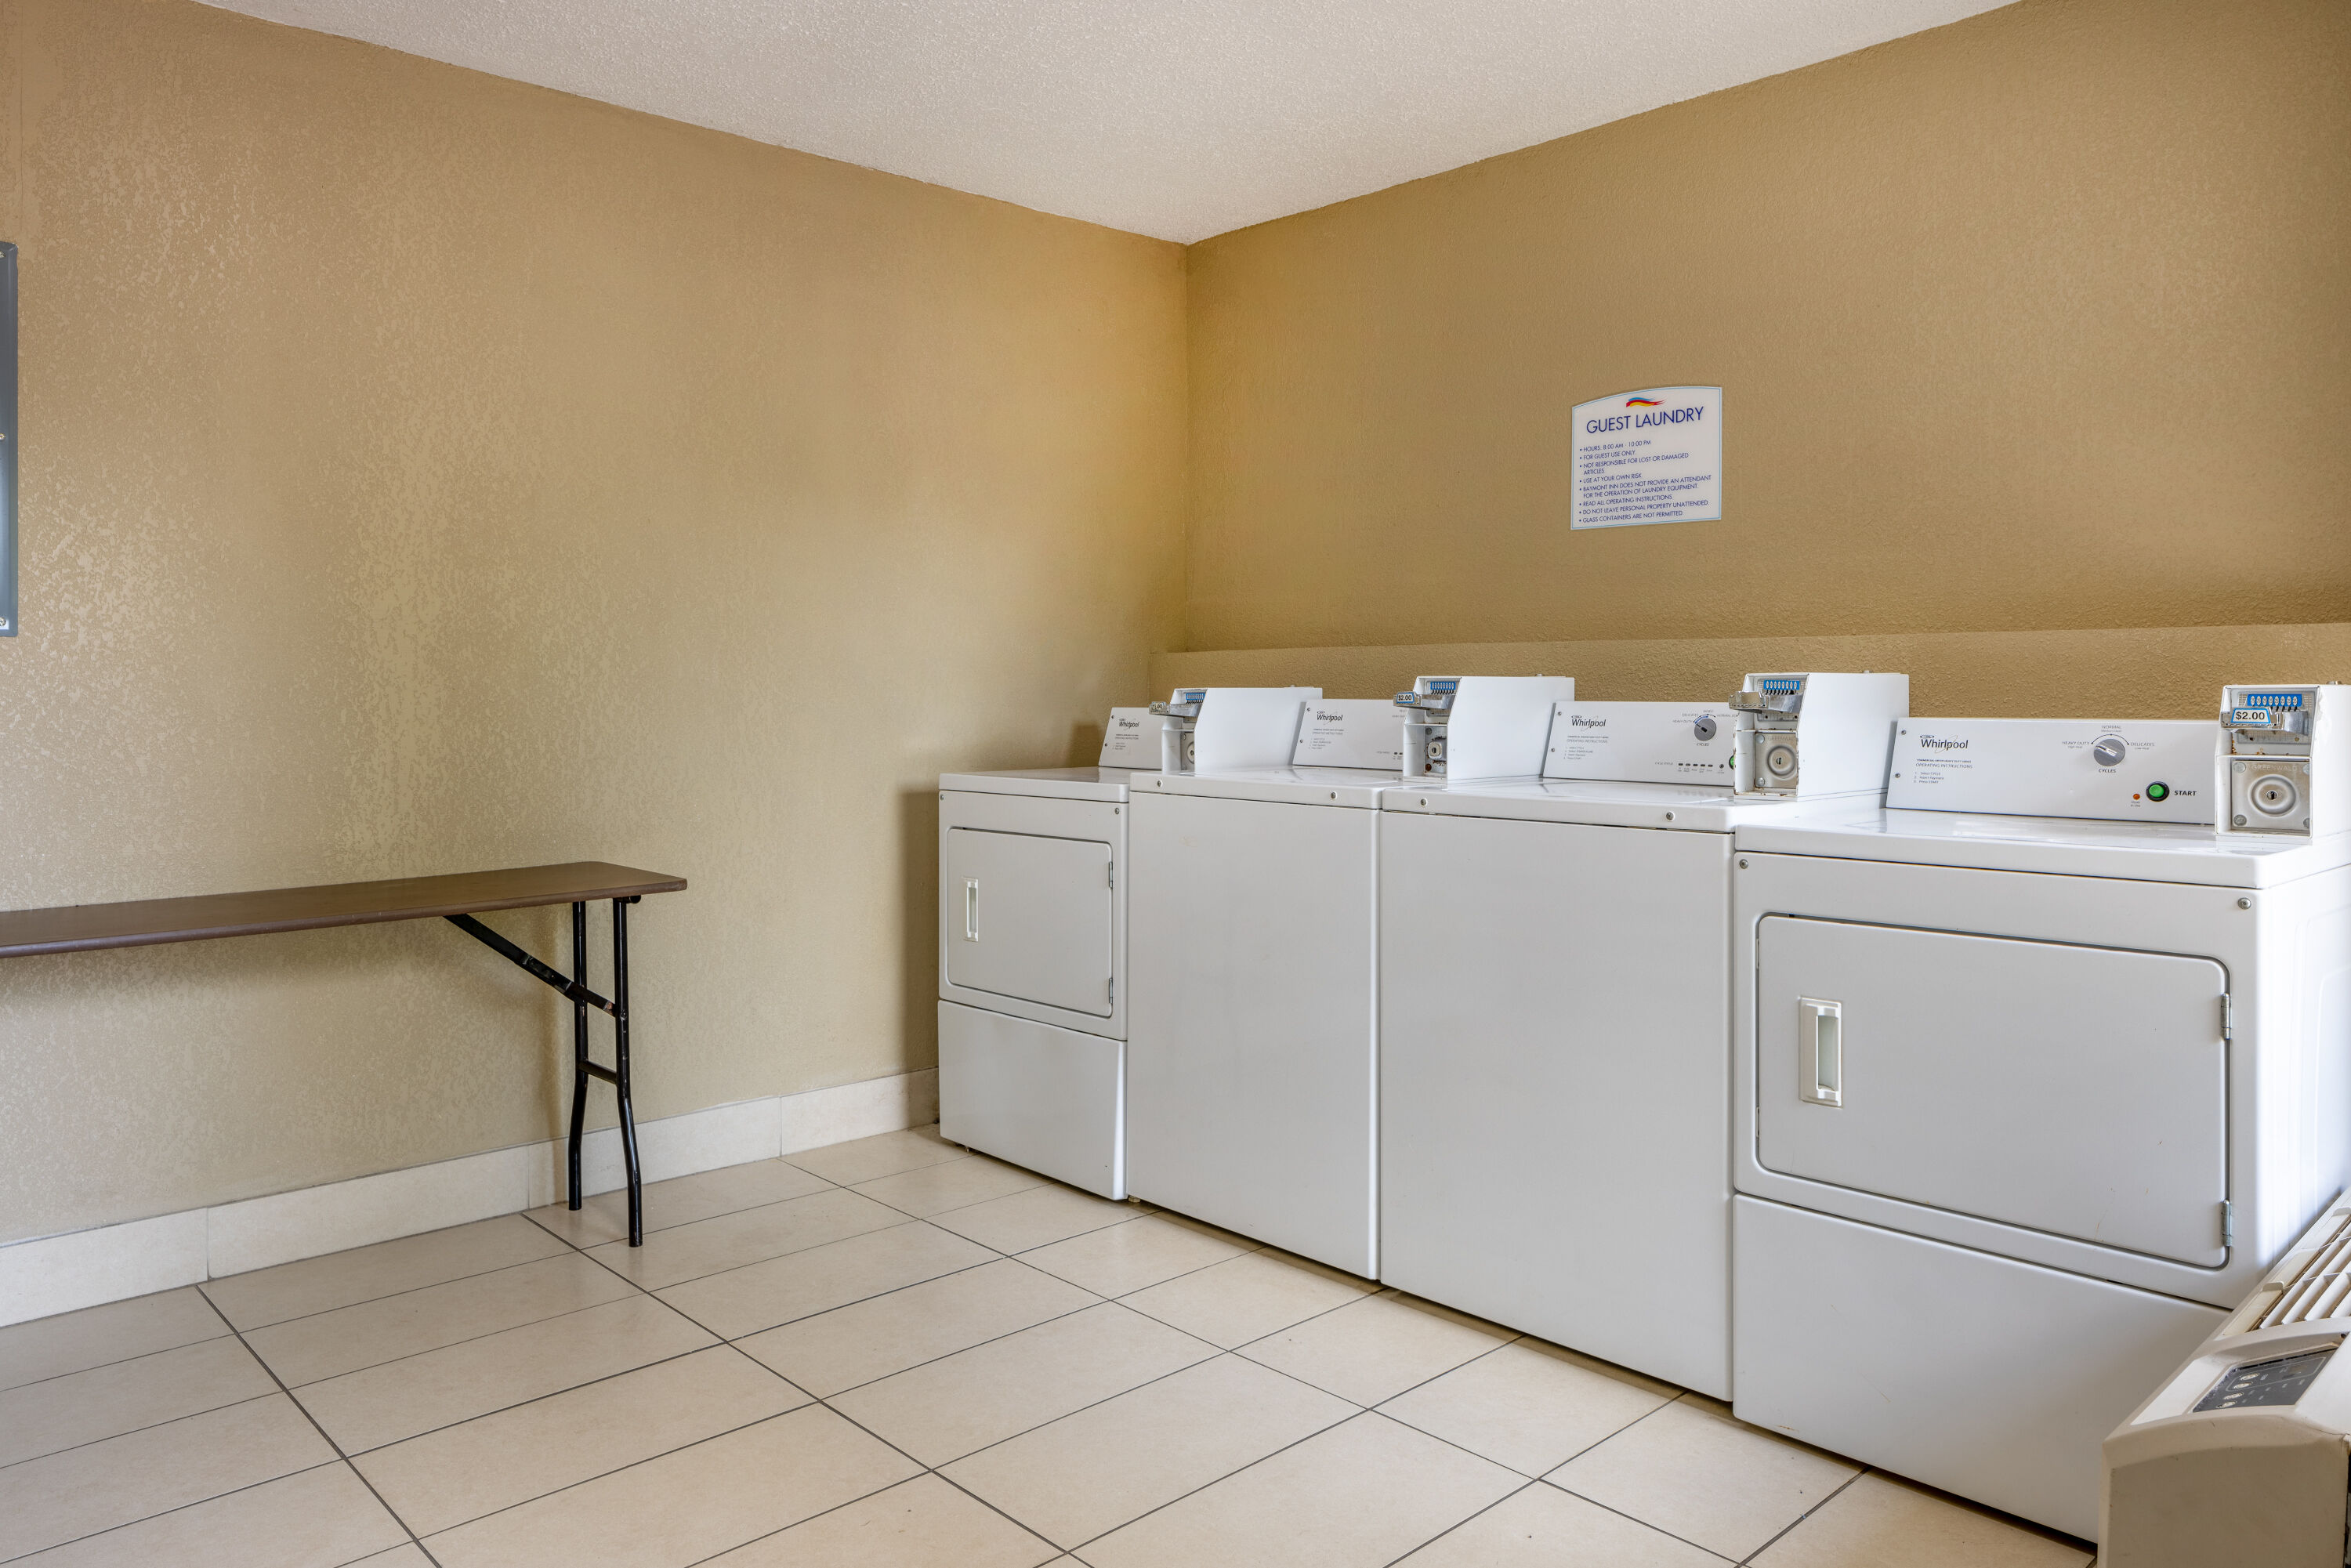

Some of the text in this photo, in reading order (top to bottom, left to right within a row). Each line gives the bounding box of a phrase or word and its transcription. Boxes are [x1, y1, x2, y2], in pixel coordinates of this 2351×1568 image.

[1587, 406, 1704, 433] GUEST LAUNDRY
[1595, 458, 1626, 467] RESPONSIBLE
[1661, 452, 1690, 461] DAMAGED
[1606, 497, 1635, 505] OPERATING
[1672, 499, 1709, 508] UNATTENDED.
[1317, 714, 1343, 722] Whirlpool
[2236, 712, 2266, 720] $2.00
[1571, 719, 1607, 729] Whirlpool
[1921, 738, 1969, 751] Whirlpool
